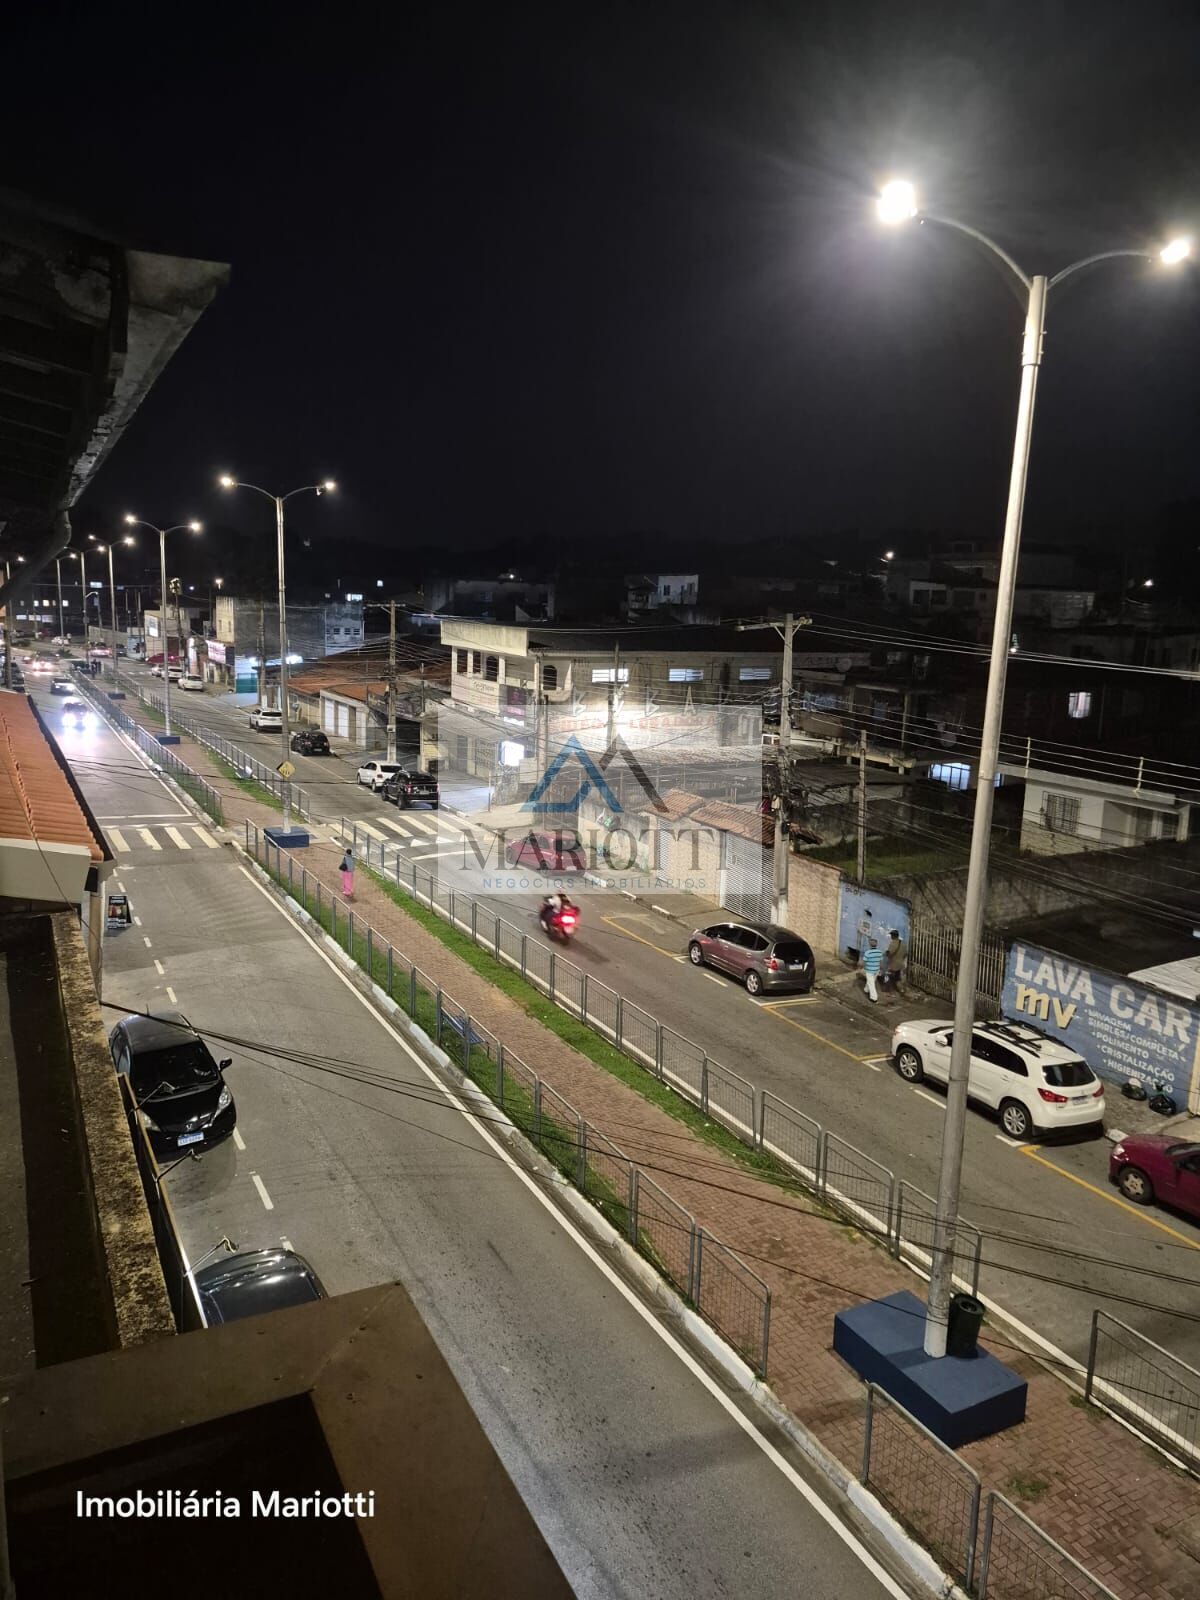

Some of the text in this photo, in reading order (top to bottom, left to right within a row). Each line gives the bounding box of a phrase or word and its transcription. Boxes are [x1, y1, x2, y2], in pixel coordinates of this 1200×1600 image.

[1014, 946, 1193, 1045] LAVA CAR
[1088, 1009, 1132, 1032] LAVAGEM
[1096, 1031, 1150, 1060] POLIMENTO
[1101, 1044, 1175, 1082] CRISTALIZAÇÃO
